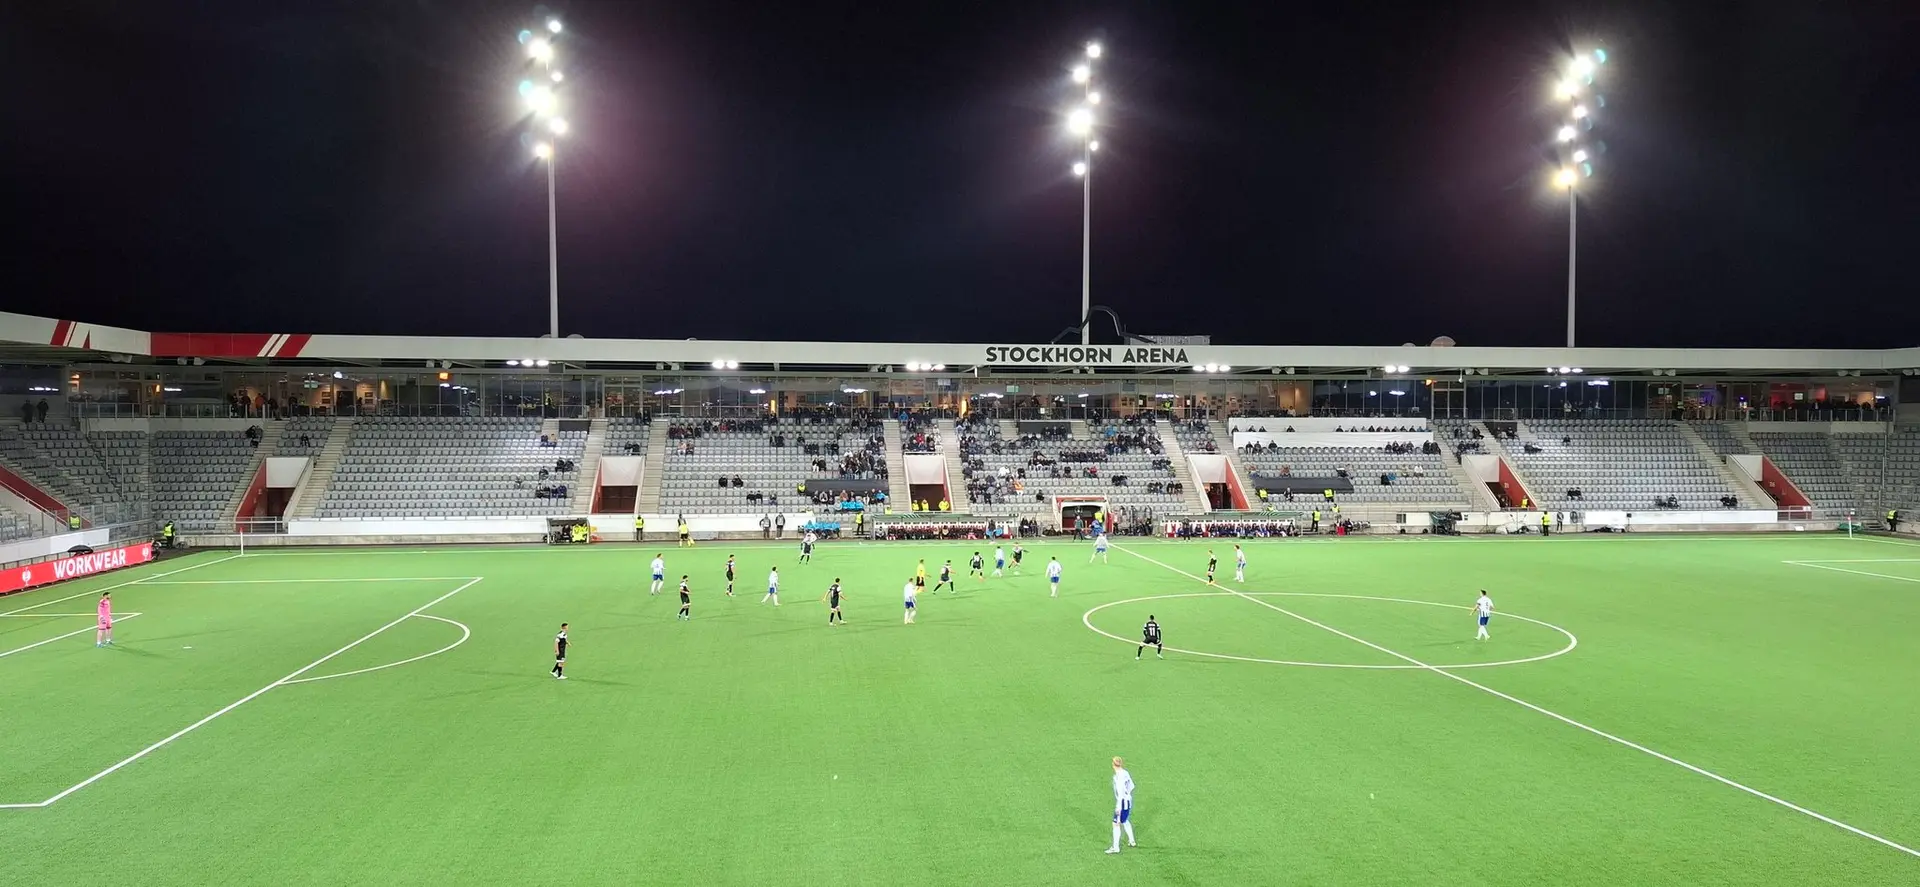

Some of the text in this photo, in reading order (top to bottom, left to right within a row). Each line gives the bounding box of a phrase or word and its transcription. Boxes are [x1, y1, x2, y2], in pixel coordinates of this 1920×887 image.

[986, 347, 1189, 363] STOCKHORN ARENA
[53, 549, 126, 579] WORKWEAR
[1148, 627, 1156, 636] 11
